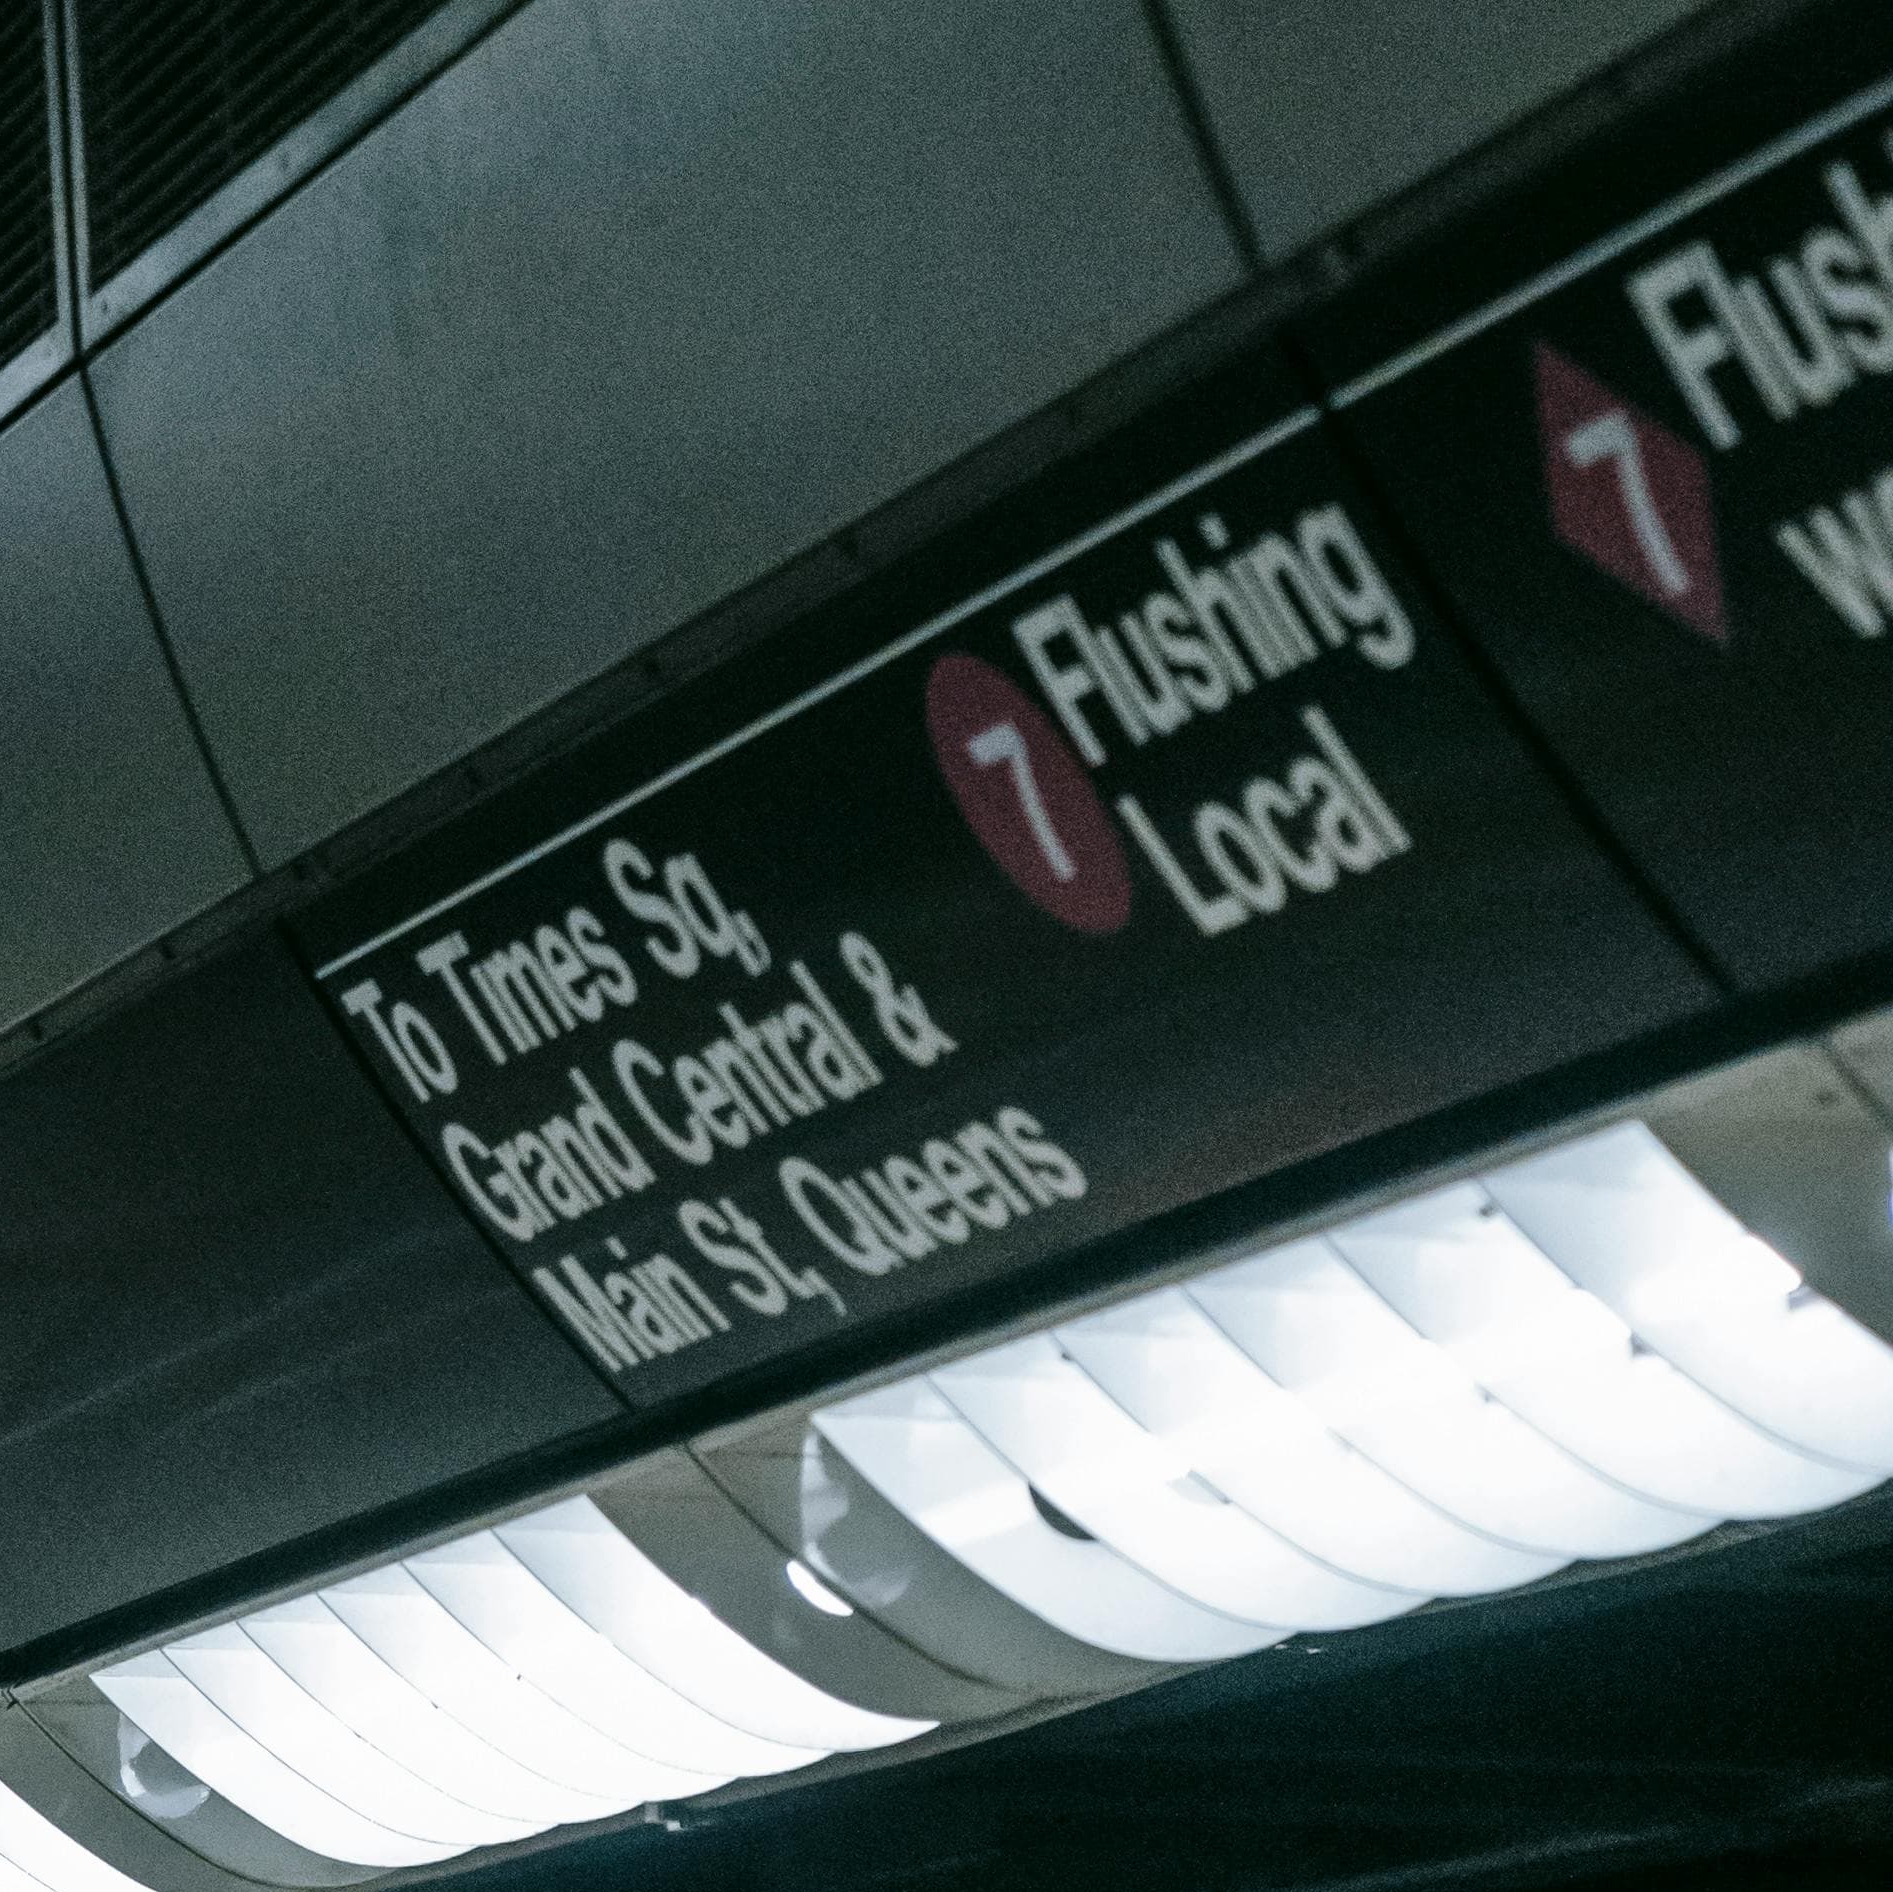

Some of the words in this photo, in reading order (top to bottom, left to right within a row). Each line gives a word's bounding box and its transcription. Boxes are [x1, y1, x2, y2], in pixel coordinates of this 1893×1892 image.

[1564, 406, 1693, 598] 7
[1012, 501, 1417, 767] Flushing
[966, 722, 1077, 881] 7
[1116, 704, 1411, 935] Local
[341, 977, 458, 1102] To
[415, 905, 639, 1066] Times
[441, 1066, 656, 1242] Grand
[612, 959, 884, 1165] Central
[838, 930, 958, 1067] &
[532, 1236, 732, 1374] Main
[778, 1105, 1089, 1276] Queens
